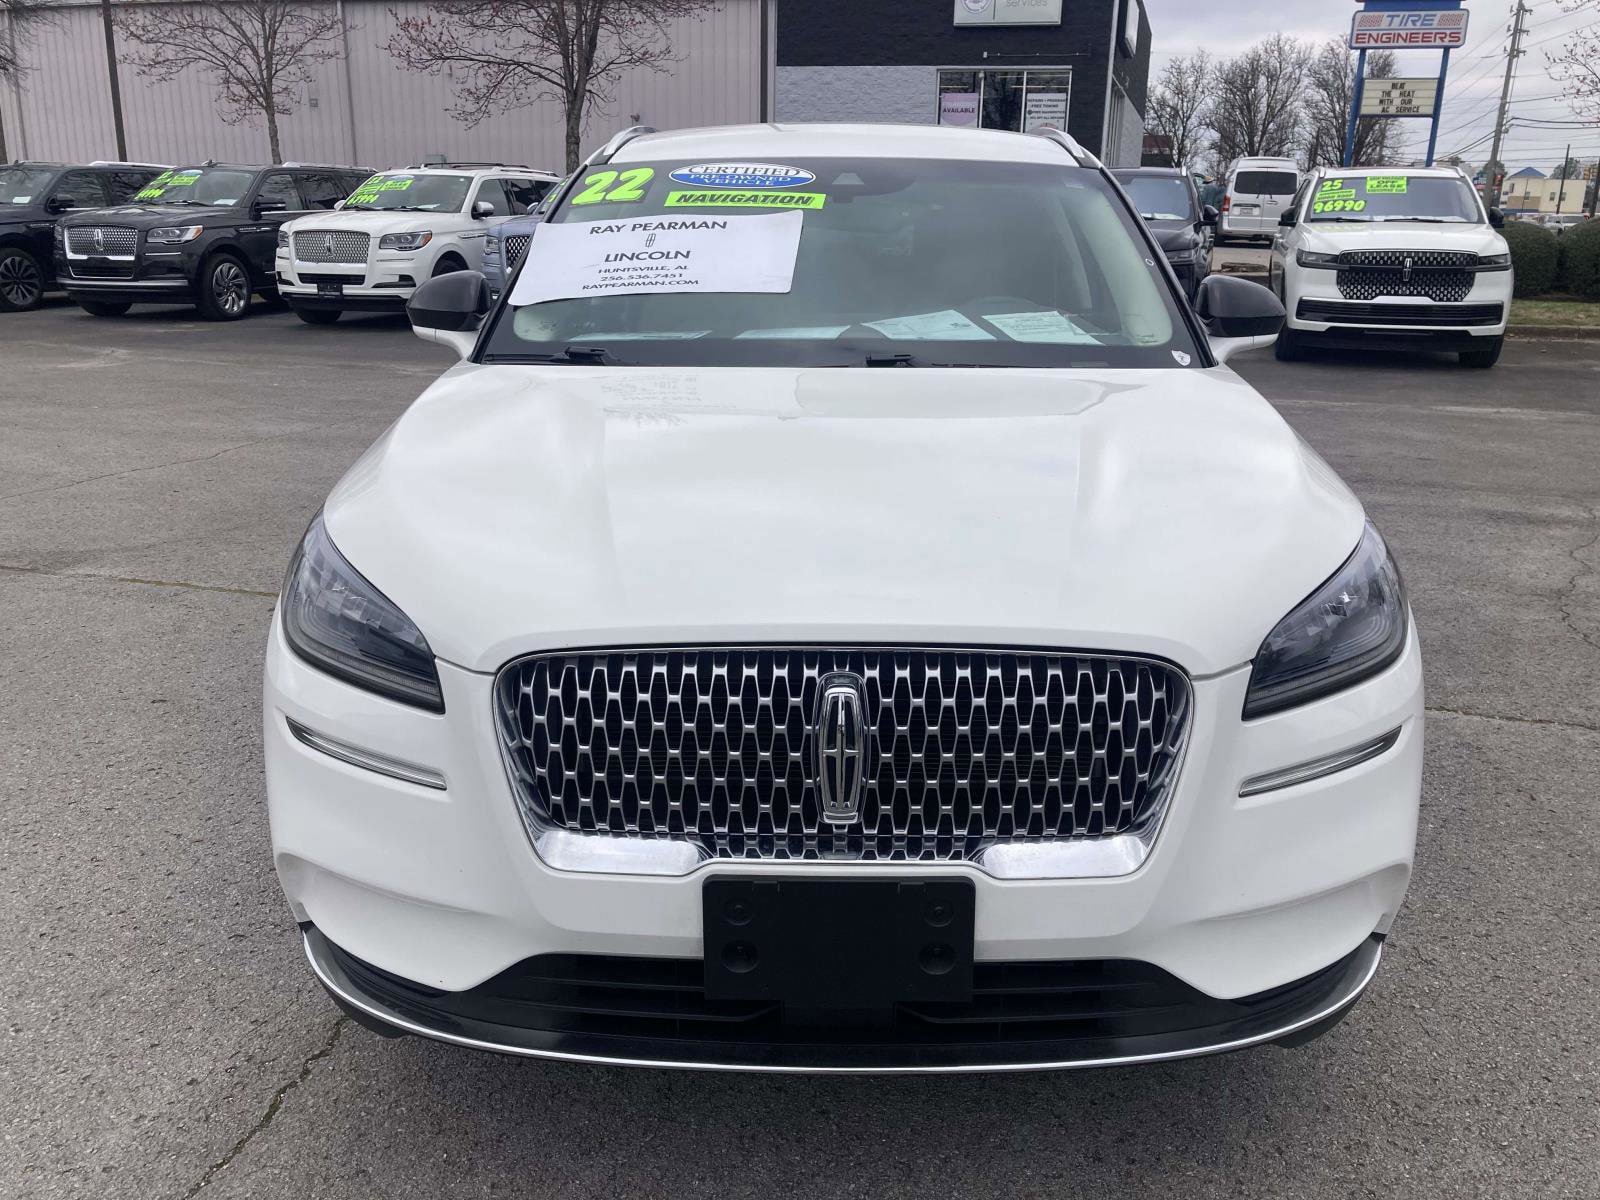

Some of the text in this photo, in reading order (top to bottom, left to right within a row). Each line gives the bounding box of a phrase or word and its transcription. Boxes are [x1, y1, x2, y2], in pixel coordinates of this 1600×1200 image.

[1386, 14, 1437, 27] TIRE
[1355, 32, 1461, 44] ENGINEERS
[1391, 82, 1406, 90] BEAT
[1382, 90, 1415, 98] THE HEAT
[1379, 98, 1413, 106] WITH OUR
[688, 166, 801, 176] CERTIFIED
[690, 174, 792, 182] PRE-OWNED
[703, 178, 774, 186] VEHICLE
[571, 168, 655, 205] 22
[1321, 179, 1343, 191] 25
[676, 193, 815, 205] NAVIGATION
[1313, 199, 1367, 213] 96990
[589, 221, 728, 235] RAY PEARMAN
[604, 250, 691, 262] LINCOLN
[598, 266, 670, 274] HUNTSVILLE,
[600, 273, 683, 281] 256.536.7451
[582, 279, 701, 290] RAYPEARMAN.COM
